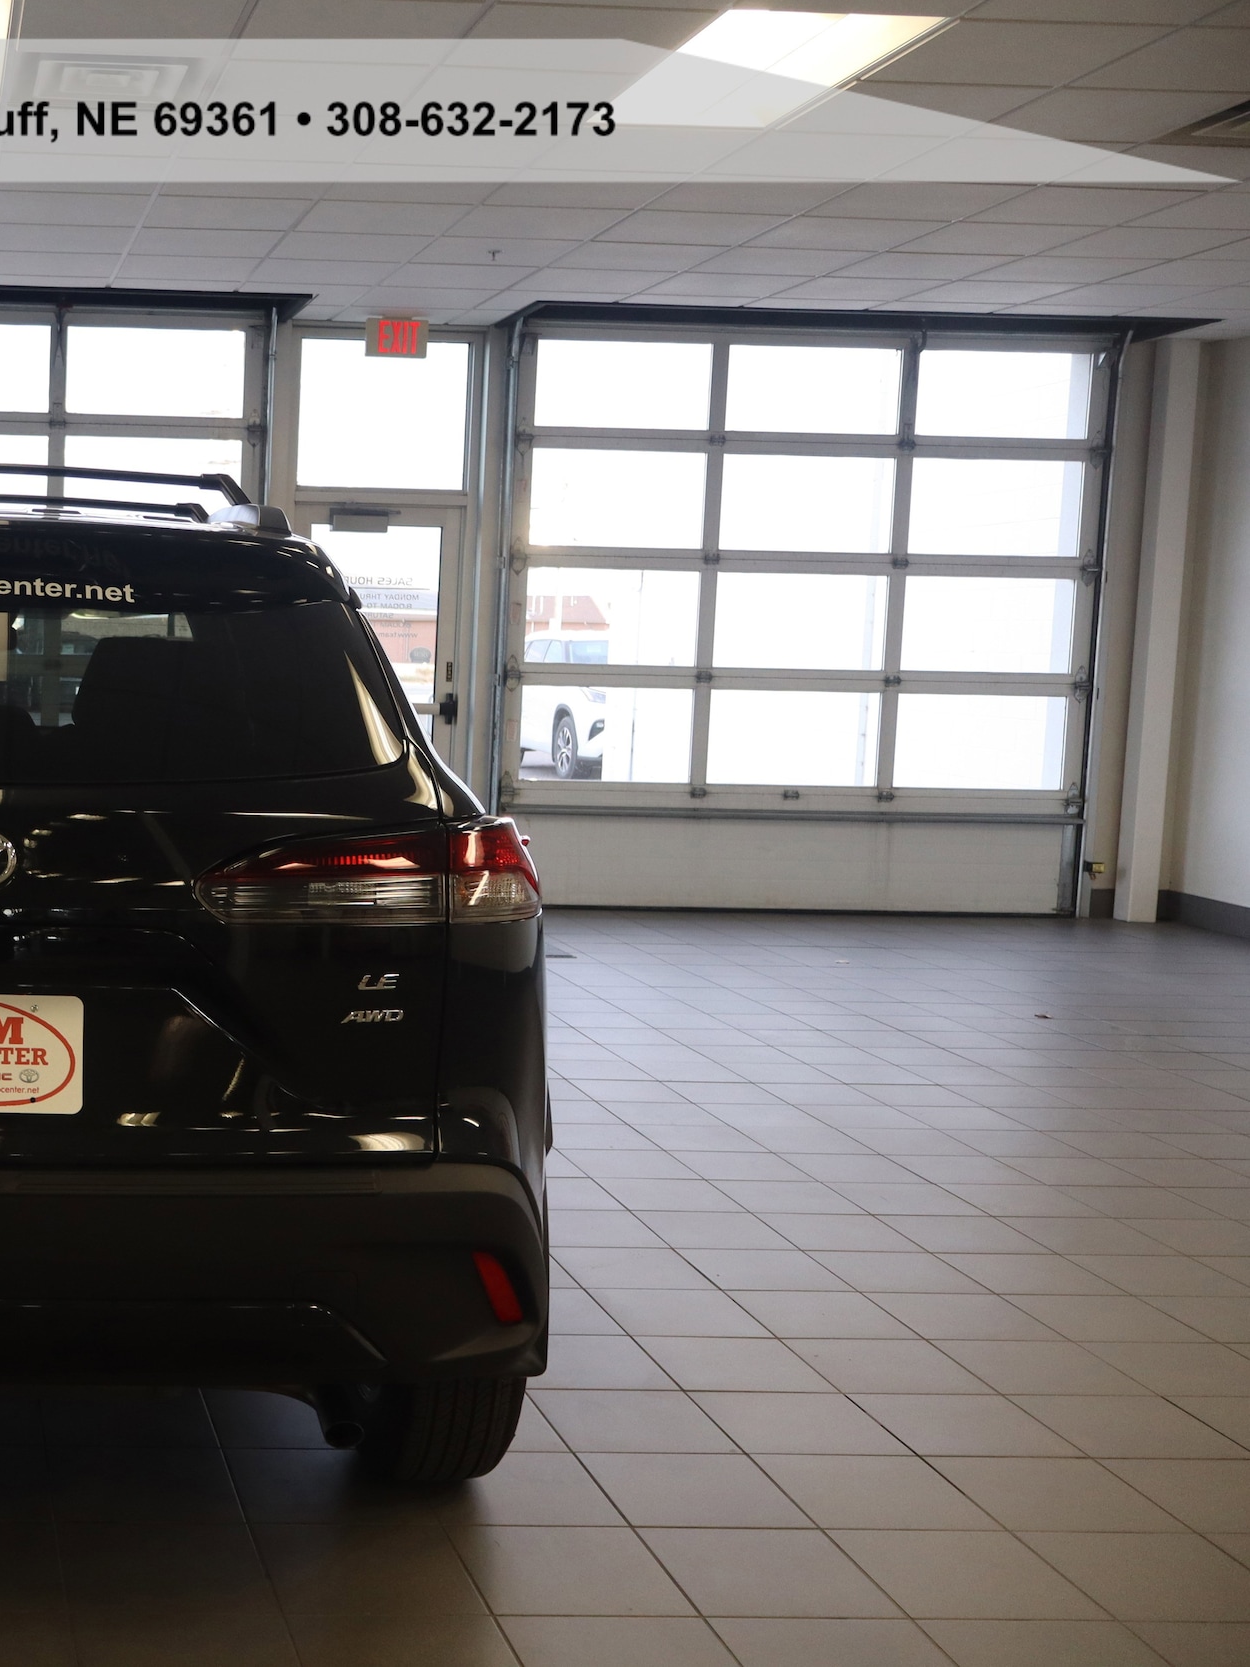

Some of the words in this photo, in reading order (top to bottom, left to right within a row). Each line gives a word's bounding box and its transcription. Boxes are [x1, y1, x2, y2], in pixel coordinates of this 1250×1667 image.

[378, 320, 421, 354] EXIT
[357, 973, 400, 991] LE
[341, 1009, 404, 1024] AWD
